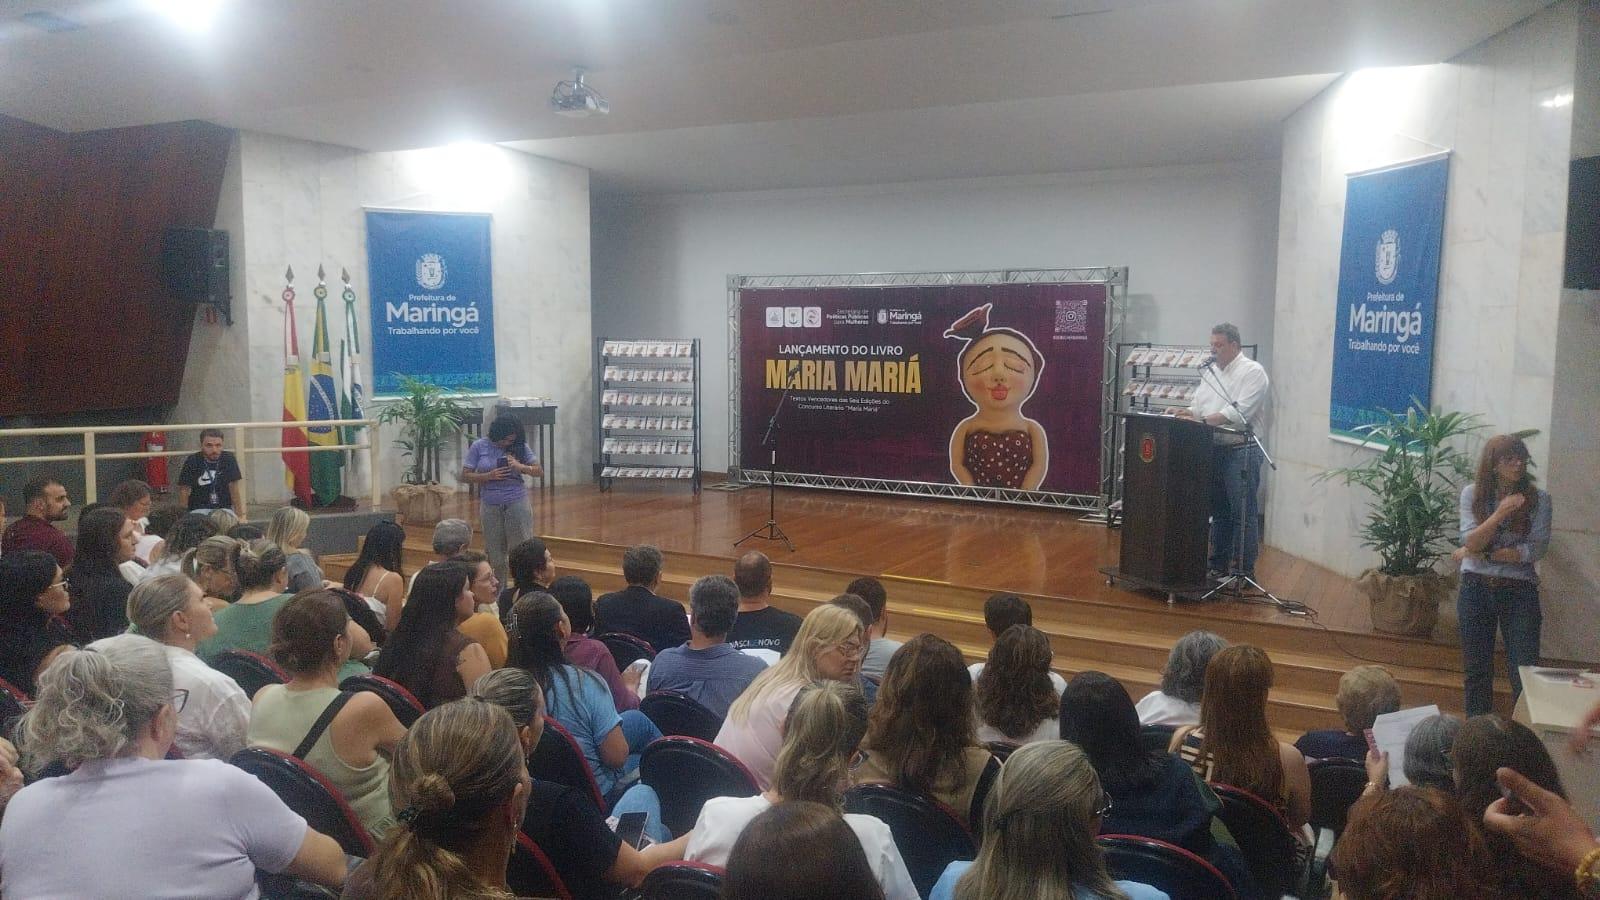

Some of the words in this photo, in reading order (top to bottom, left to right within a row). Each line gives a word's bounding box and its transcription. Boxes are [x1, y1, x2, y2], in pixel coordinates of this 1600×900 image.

[1367, 292, 1395, 302] Prefeitura
[1395, 291, 1404, 301] de
[386, 301, 479, 327] Maringá
[889, 311, 922, 322] Maringá
[1349, 302, 1422, 342] Maringá
[388, 327, 441, 335] Trabalhando
[443, 328, 457, 336] por
[459, 326, 479, 334] você
[779, 344, 848, 357] LANÇAMENTO
[851, 345, 868, 356] DO
[871, 345, 903, 356] LIVRO
[1348, 338, 1387, 352] Trabalhando
[1388, 343, 1400, 354] por
[1401, 342, 1420, 354] você
[766, 359, 837, 391] MARIA
[844, 353, 922, 394] MARIÁ
[758, 638, 781, 647] NOVO
